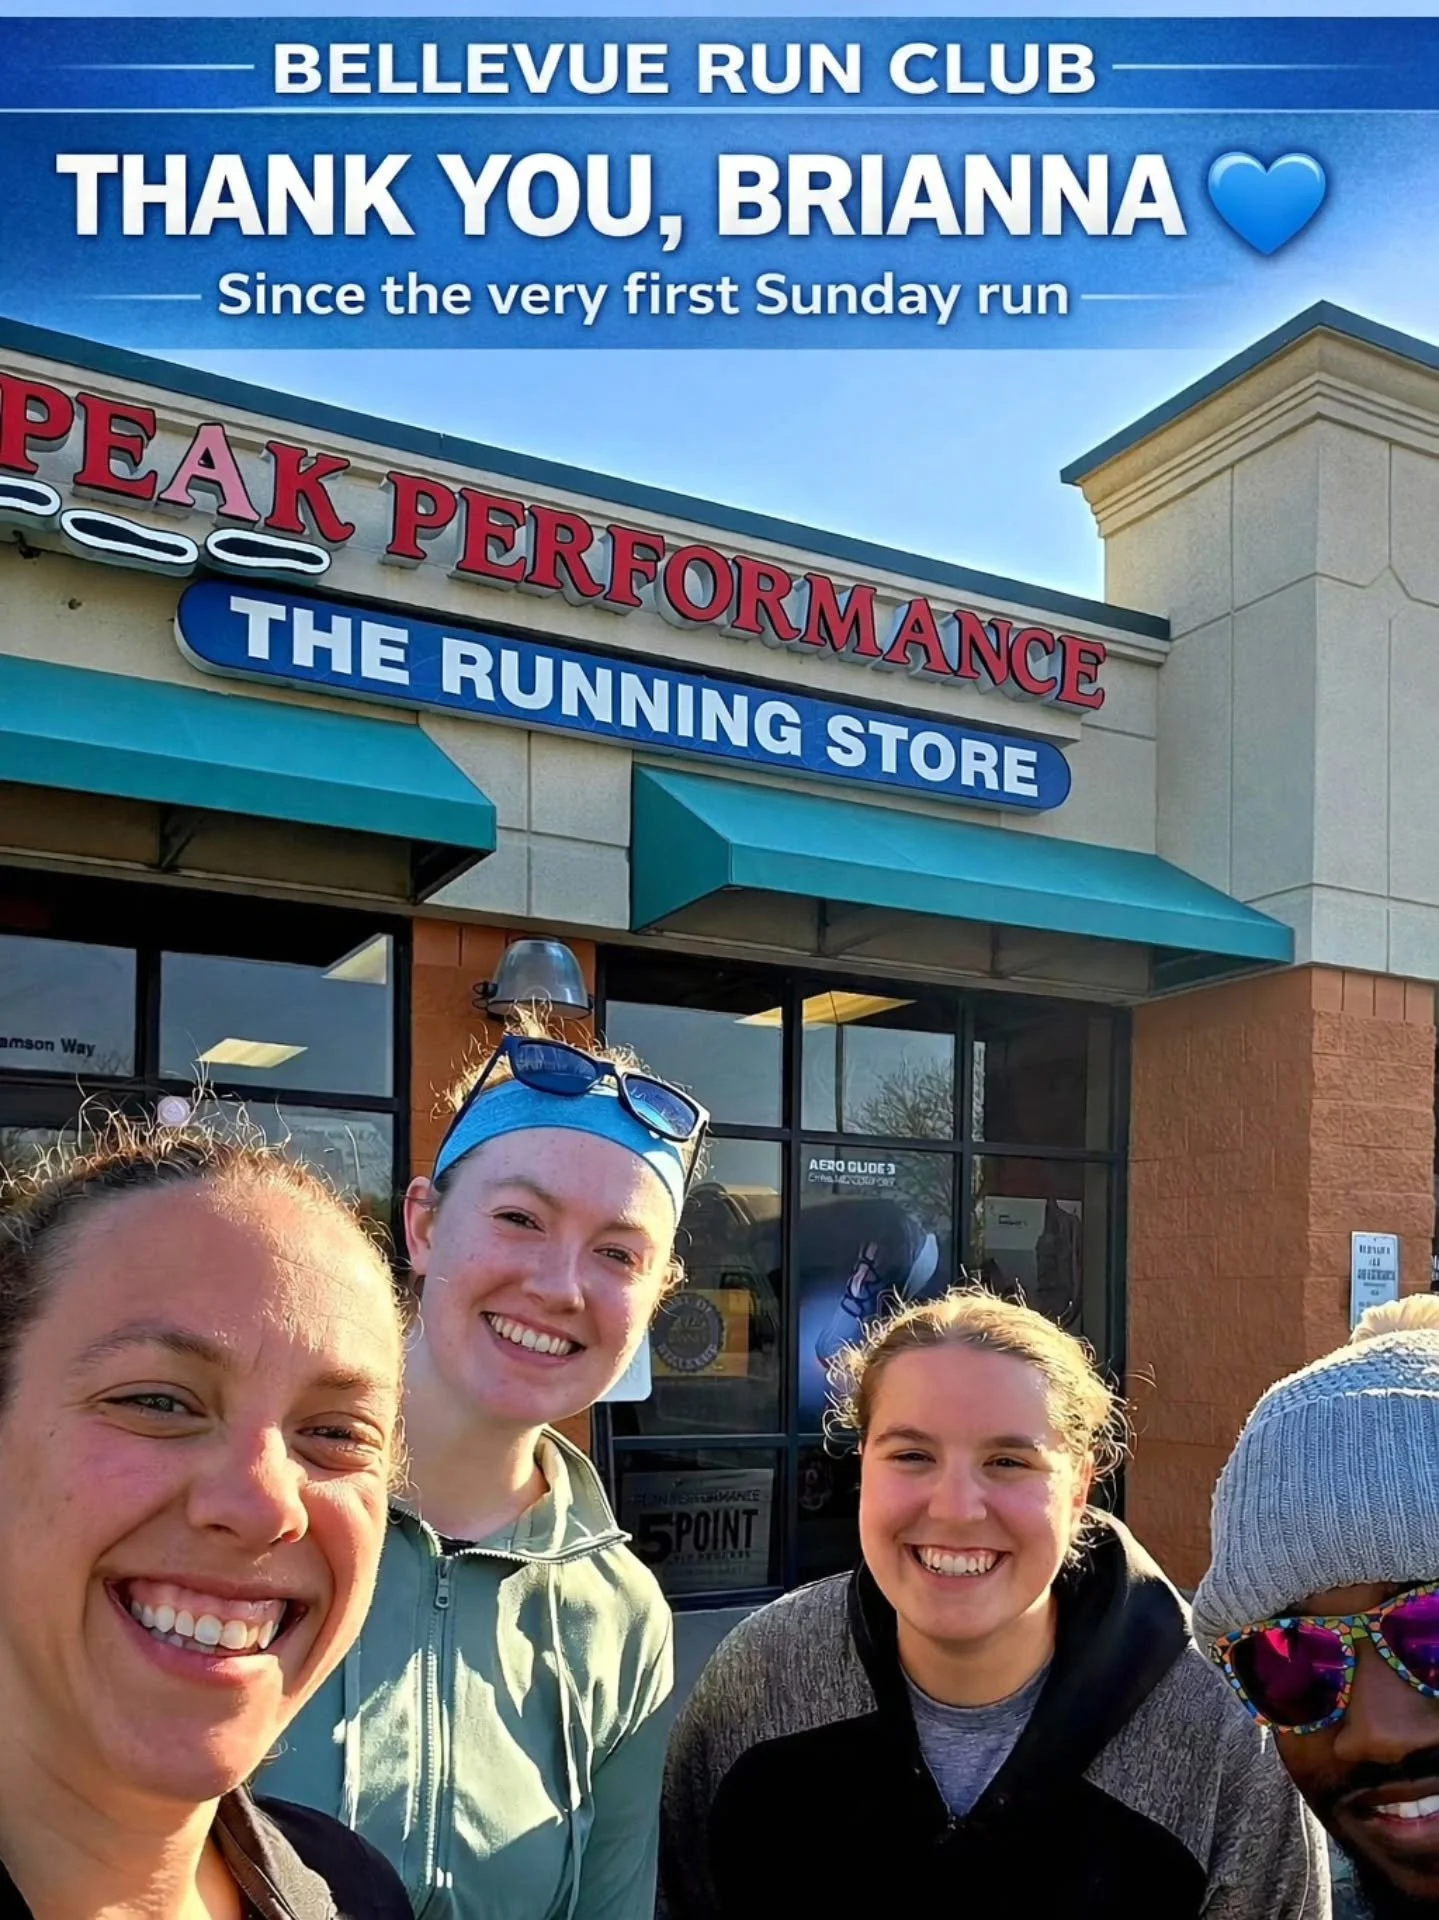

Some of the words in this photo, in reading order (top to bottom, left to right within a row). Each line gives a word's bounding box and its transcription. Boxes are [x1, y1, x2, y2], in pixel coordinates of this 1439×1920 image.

[0, 373, 355, 543] PEAK
[388, 471, 1107, 709] PERFORMANCE
[230, 596, 410, 686] THE
[442, 637, 802, 757] RUNNING
[826, 715, 1039, 797] STORE
[60, 1038, 96, 1057] Way
[809, 1158, 846, 1172] AERO
